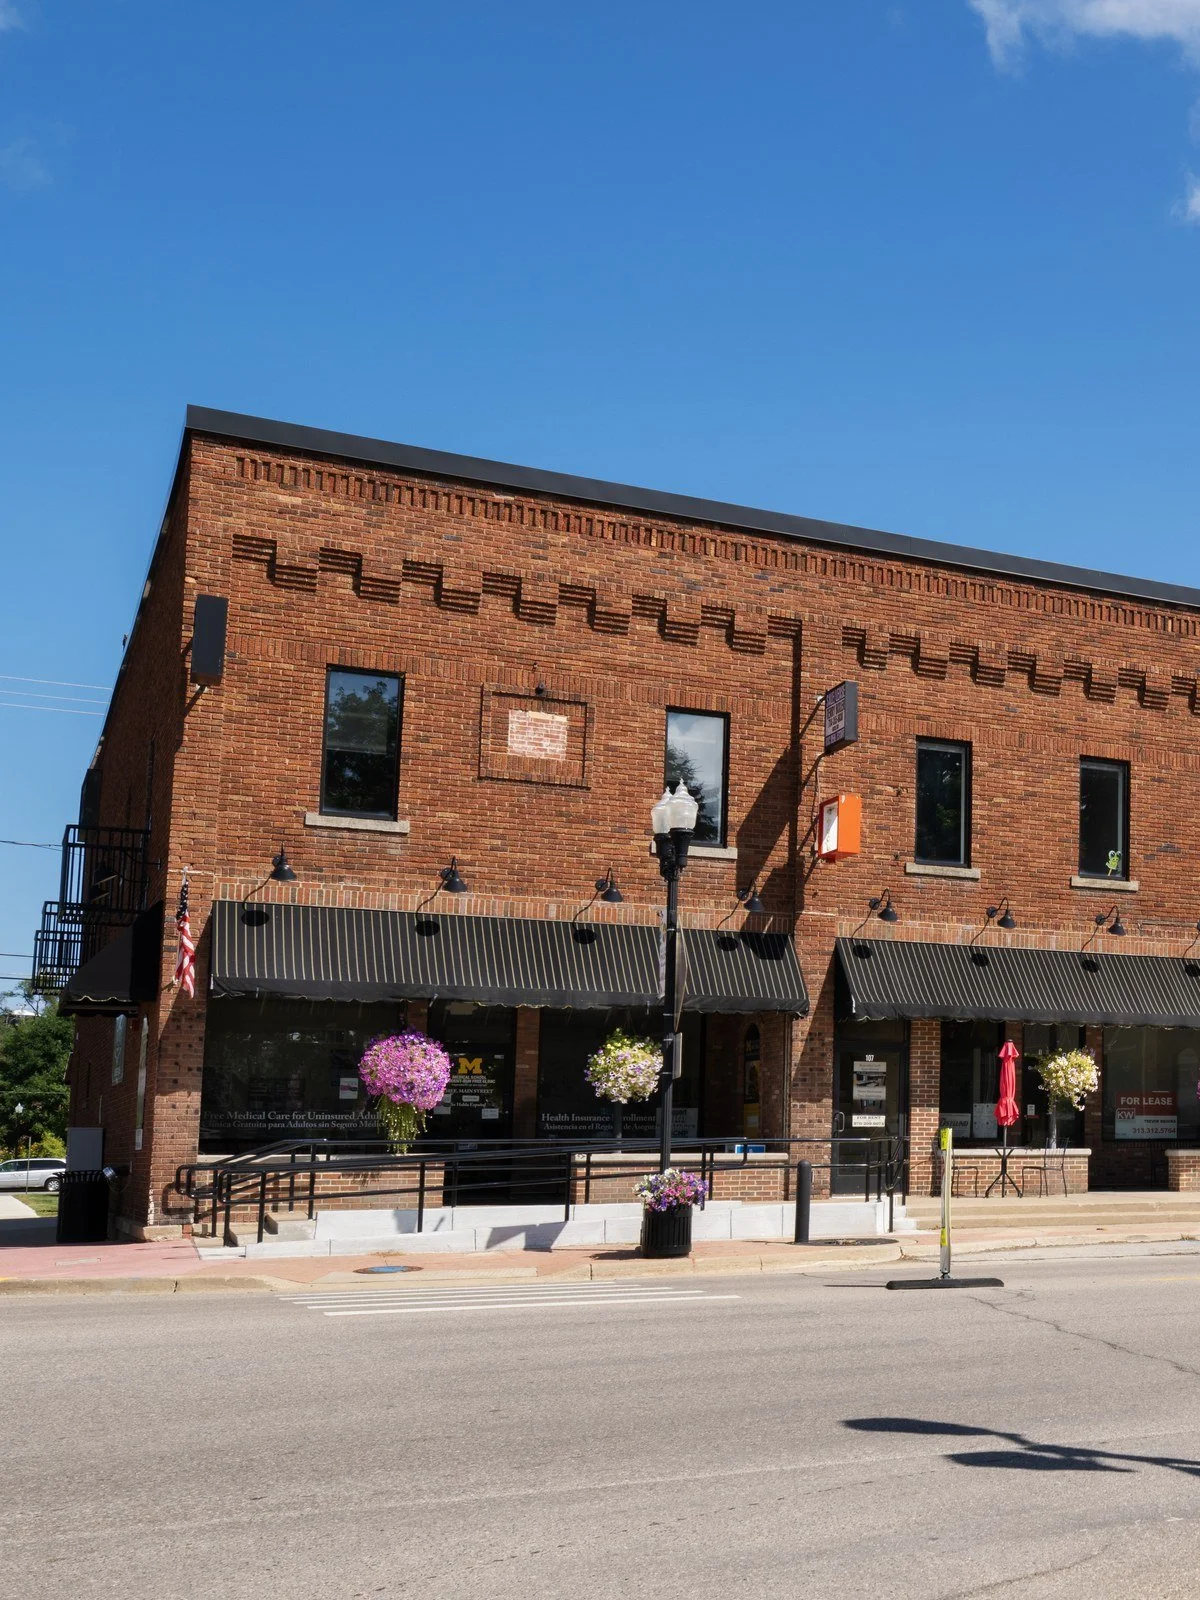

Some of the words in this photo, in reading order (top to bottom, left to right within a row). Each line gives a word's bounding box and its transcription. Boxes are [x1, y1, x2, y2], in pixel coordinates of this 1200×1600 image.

[458, 1057, 483, 1075] M
[1120, 1096, 1140, 1105] FOR
[1142, 1097, 1173, 1106] LEASE
[227, 1111, 266, 1120] Medical
[267, 1111, 289, 1120] Care
[292, 1111, 306, 1120] for
[307, 1111, 355, 1120] Uninsured
[541, 1113, 570, 1122] Health
[571, 1113, 611, 1122] Insurance
[614, 1113, 656, 1122] rollment
[1117, 1110, 1134, 1119] KW
[232, 1120, 267, 1128] Gratuita
[286, 1120, 317, 1128] Adultos
[331, 1120, 358, 1129] Seguro
[543, 1123, 578, 1131] Asistencia
